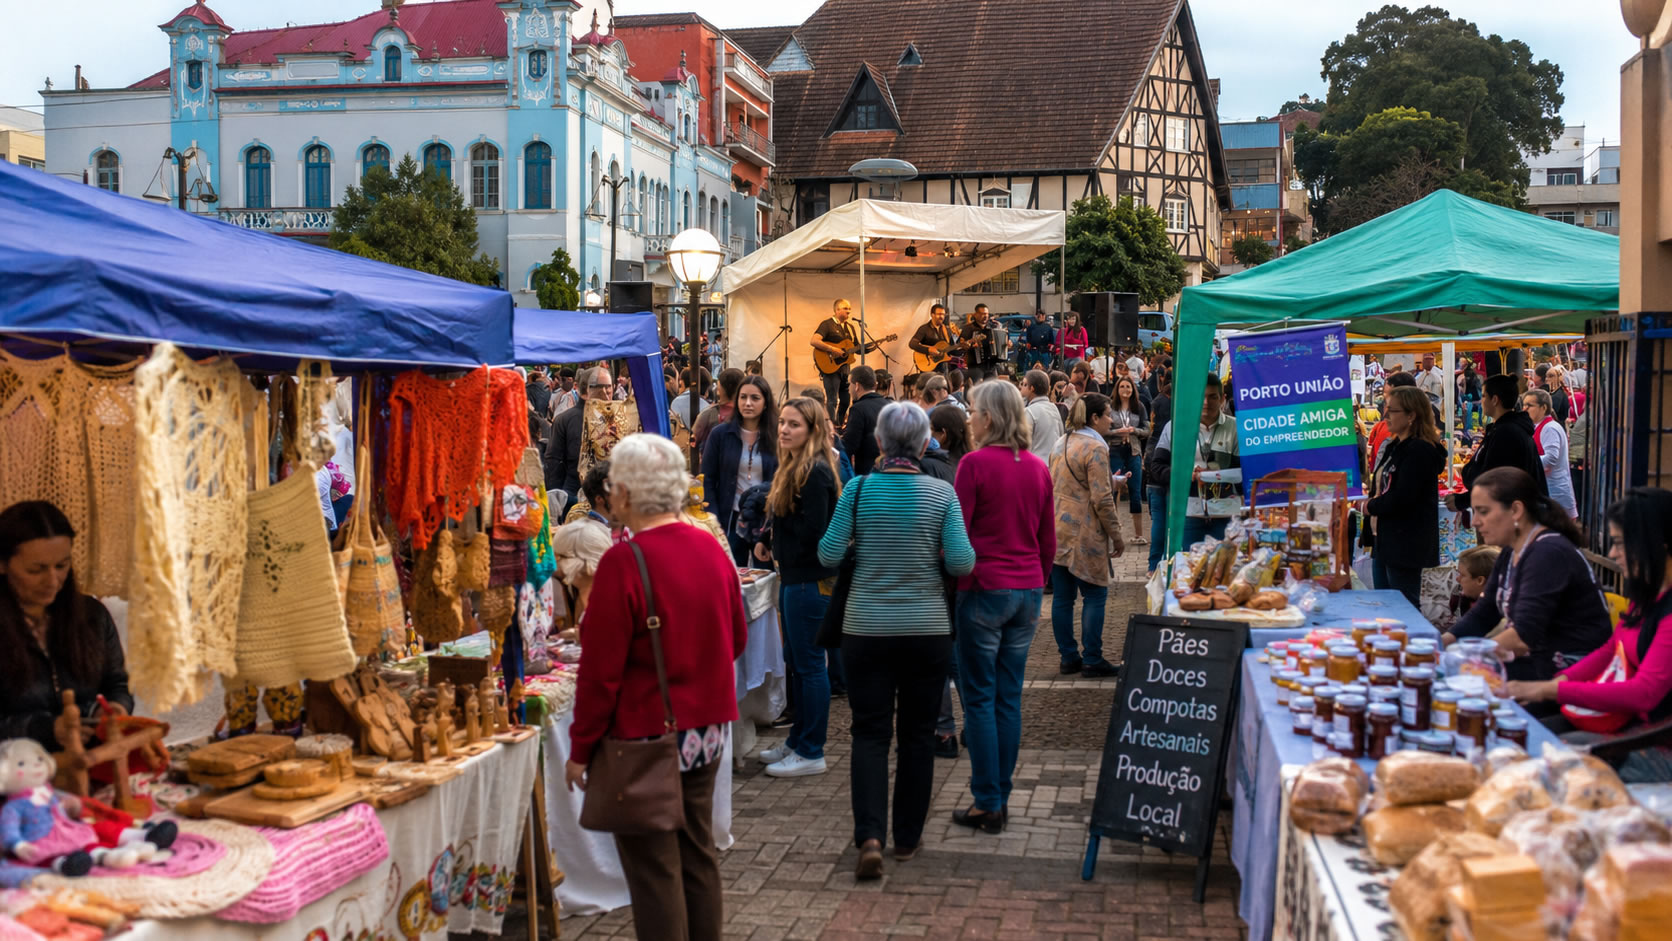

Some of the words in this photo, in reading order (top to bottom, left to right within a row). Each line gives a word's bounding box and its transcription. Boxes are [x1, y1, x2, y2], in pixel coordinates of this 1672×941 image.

[1240, 383, 1291, 401] PORTO
[1294, 375, 1344, 394] UNIÃO
[1243, 413, 1296, 431] CIDADE
[1300, 407, 1347, 424] AMIGA
[1245, 436, 1261, 446] DO
[1263, 426, 1349, 445] EMPREENDEDOR
[1158, 628, 1209, 656] Pães
[1146, 659, 1207, 687] Doces
[1127, 687, 1217, 723] Compotas
[1119, 720, 1210, 755] Artesanais
[1115, 754, 1201, 795] Produção
[1126, 793, 1182, 828] Local
